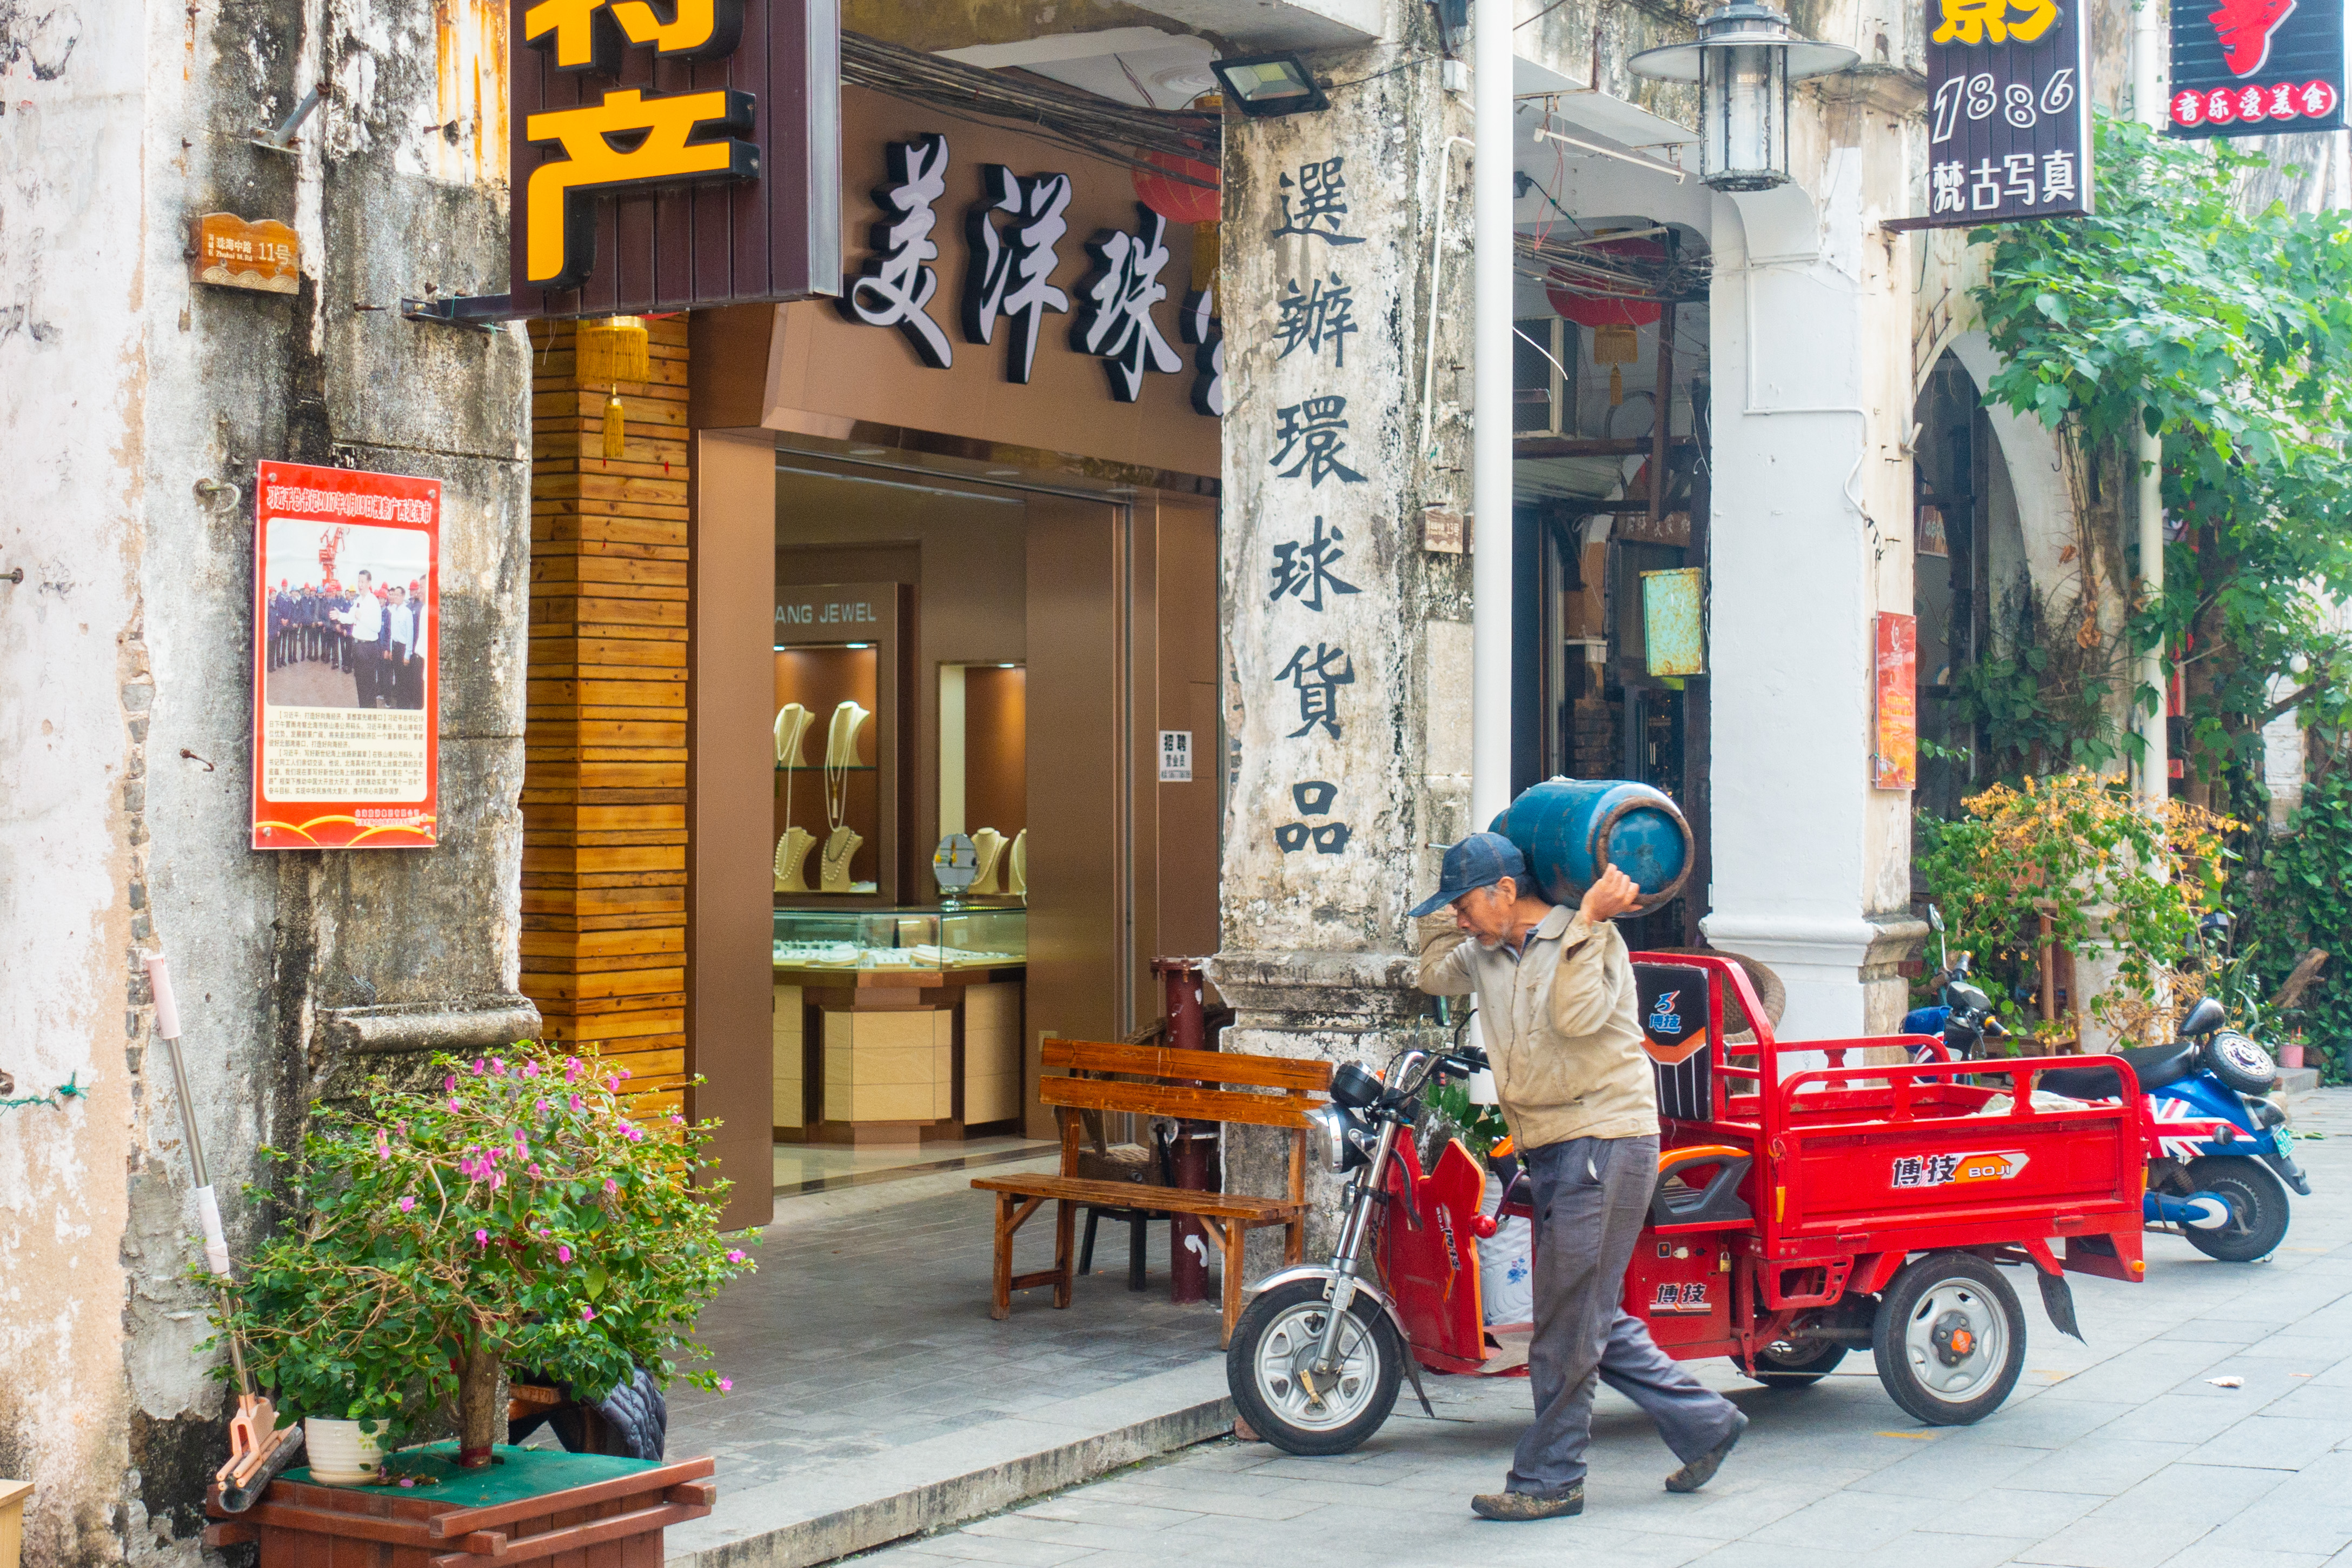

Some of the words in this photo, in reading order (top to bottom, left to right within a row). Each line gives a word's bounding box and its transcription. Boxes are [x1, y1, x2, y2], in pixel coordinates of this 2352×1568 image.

[1932, 68, 2074, 144] 1886
[2176, 83, 2328, 122] 音乐爱美食
[1933, 149, 2075, 214] 梵古写真
[216, 237, 252, 254] 珠海中路
[216, 250, 235, 260] Zhuhai
[258, 242, 290, 265] 11号
[267, 486, 432, 524] 习近平总书记2017年4月19日视察广西北海市
[819, 602, 877, 623] JEWEL
[1892, 1155, 1958, 1187] 博技
[1968, 1165, 2011, 1178] BOJI
[1656, 1283, 1707, 1304] 博技
